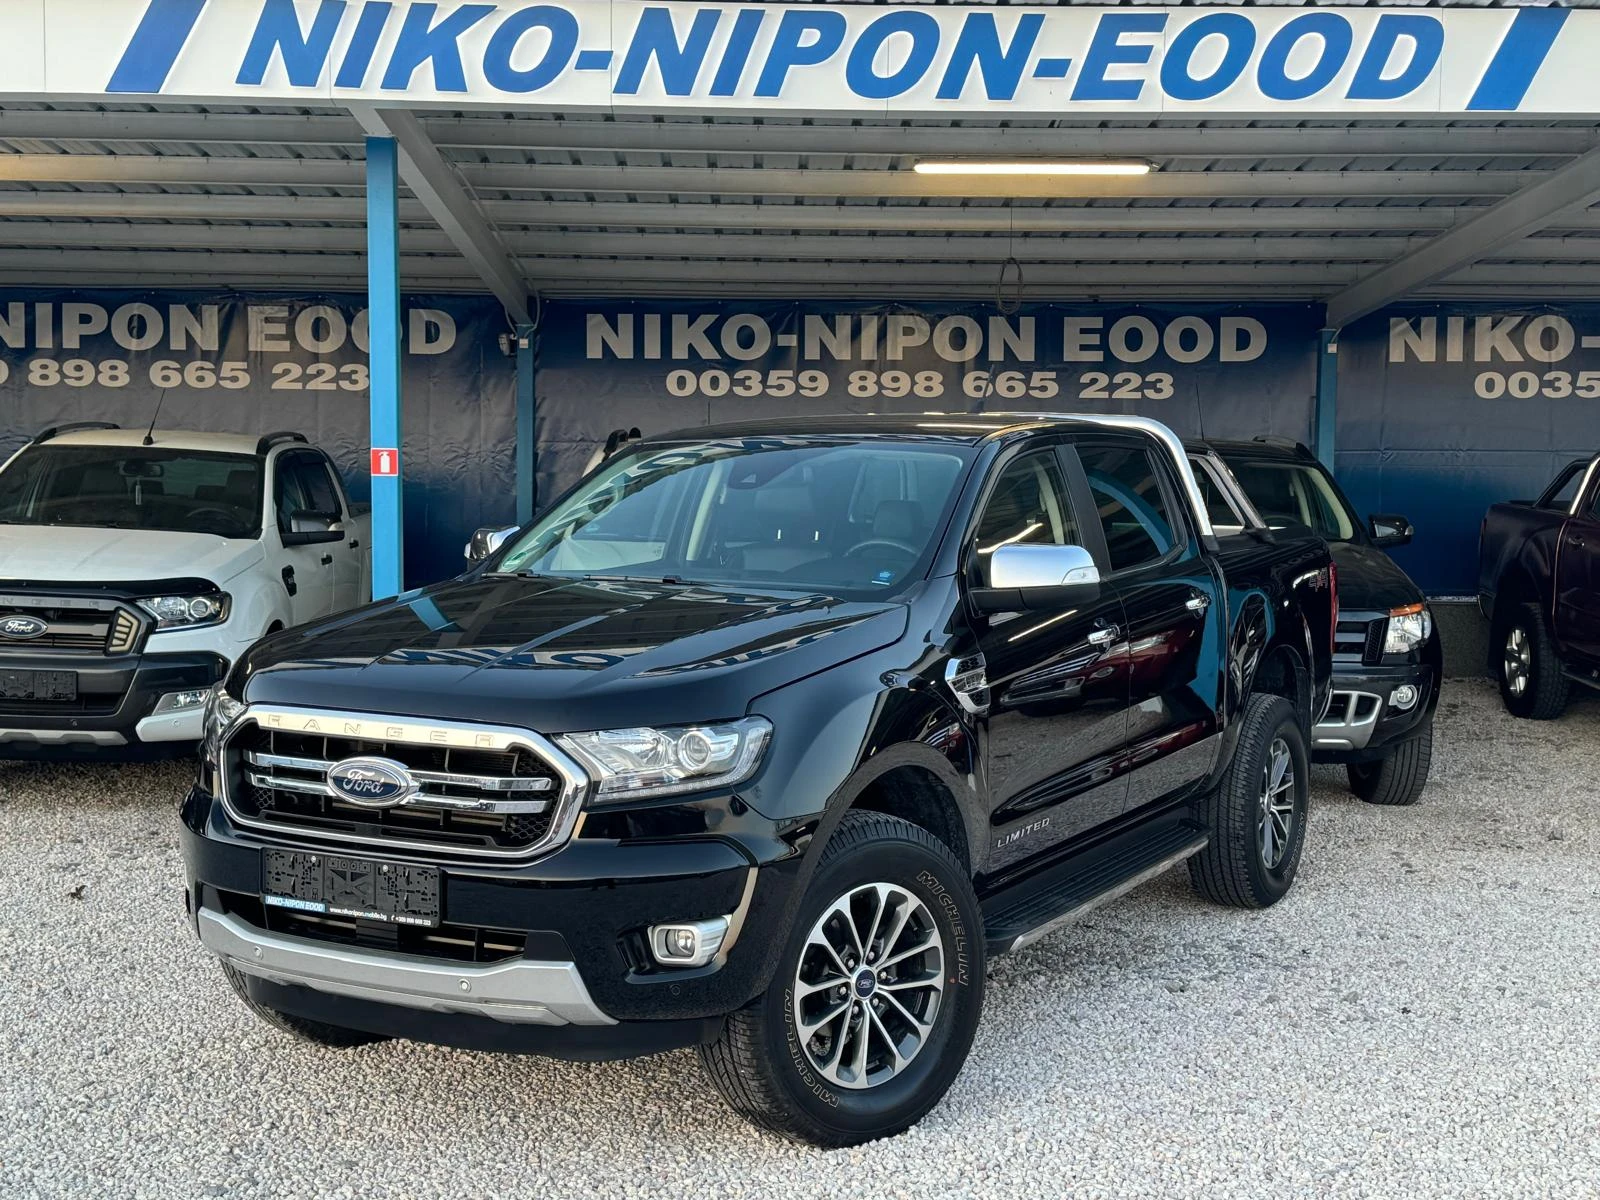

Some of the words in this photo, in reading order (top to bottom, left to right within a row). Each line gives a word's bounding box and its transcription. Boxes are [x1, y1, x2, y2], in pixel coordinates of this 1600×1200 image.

[236, 0, 1444, 102] NIKO-NIPON-EOOD
[586, 313, 1035, 363] NIKO-NIPON
[1063, 315, 1267, 364] EOOD
[28, 358, 130, 388] 898
[149, 361, 251, 389] 665
[271, 363, 370, 391] 223
[666, 369, 830, 398] 00359
[847, 370, 945, 398] 898
[962, 371, 1059, 398] 665
[1079, 372, 1175, 400] 223
[5, 620, 34, 633] Ford
[267, 714, 495, 747] RANGER
[342, 768, 385, 795] Ford
[997, 817, 1050, 848] LIMITED
[916, 870, 969, 986] MICHELIN
[784, 988, 840, 1108] MICHELIN
